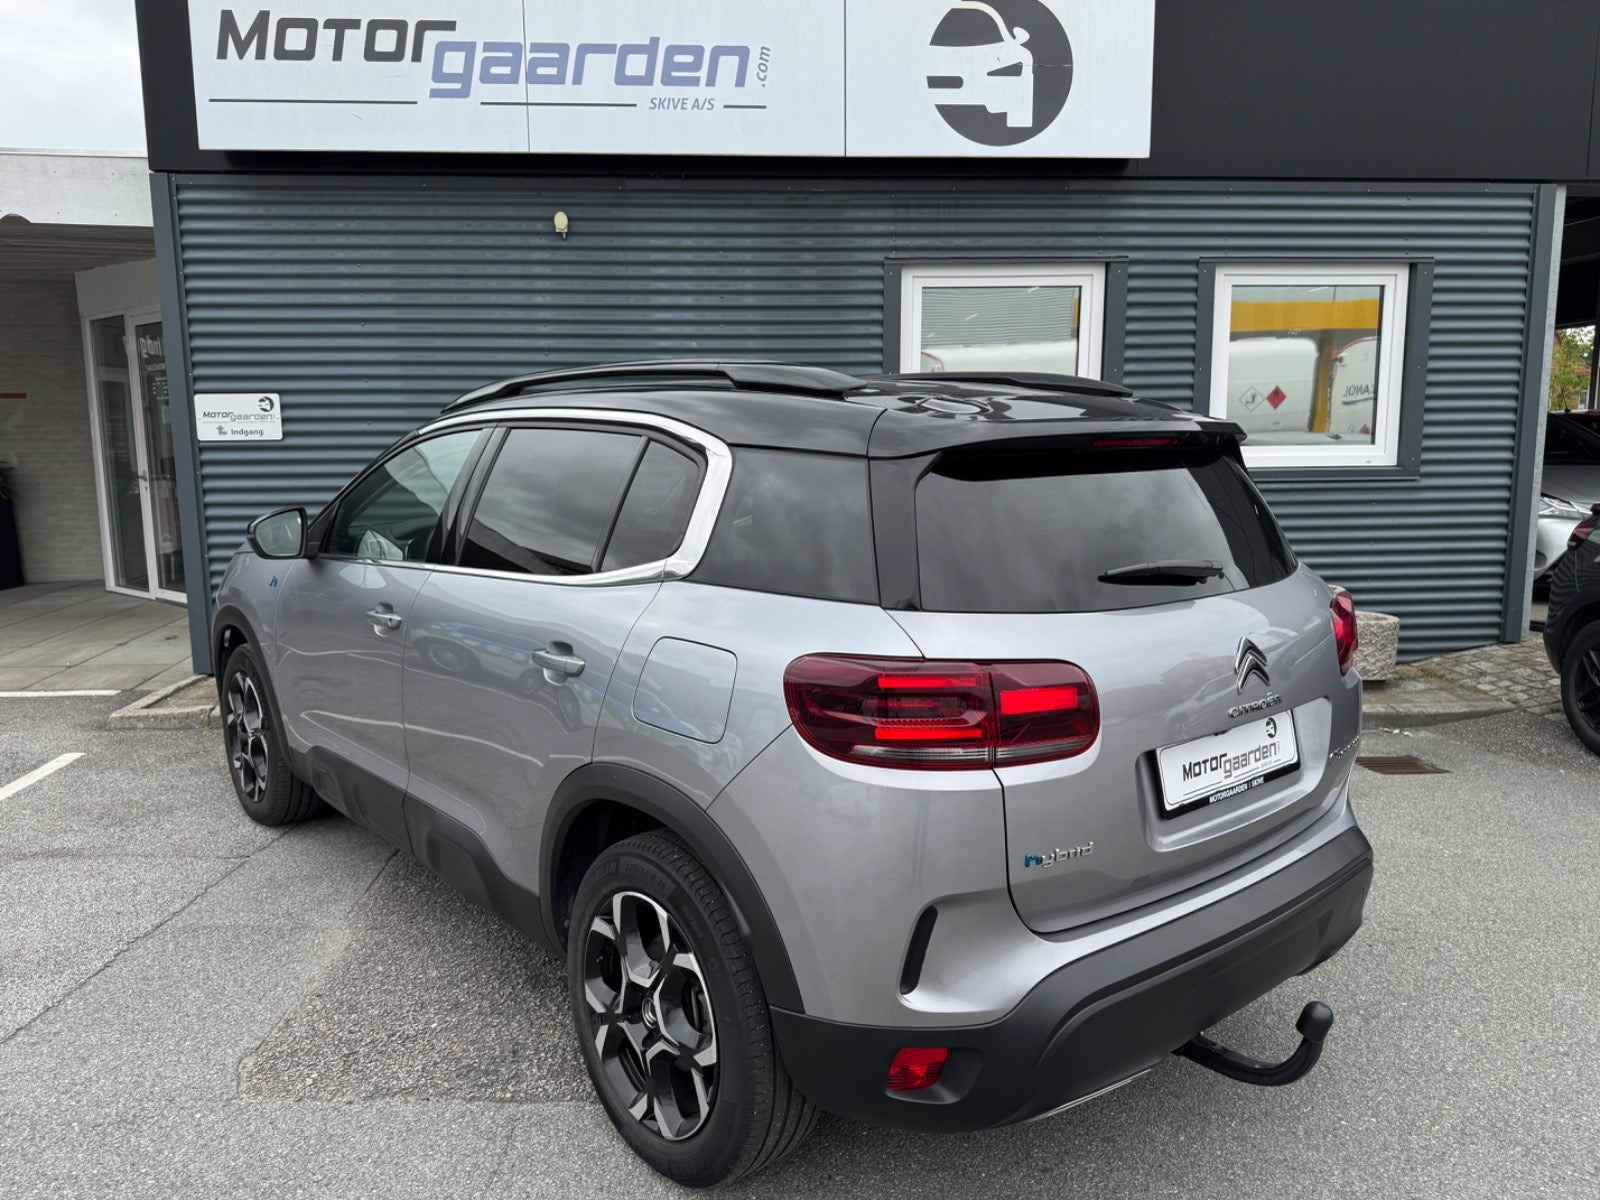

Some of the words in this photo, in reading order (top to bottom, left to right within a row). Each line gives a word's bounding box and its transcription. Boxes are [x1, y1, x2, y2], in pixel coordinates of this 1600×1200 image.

[757, 46, 771, 88] .com
[649, 97, 688, 111] SKIVE
[691, 98, 715, 111] A/S
[231, 428, 264, 437] Indgang
[1209, 782, 1248, 804] MOTORGAARDEN
